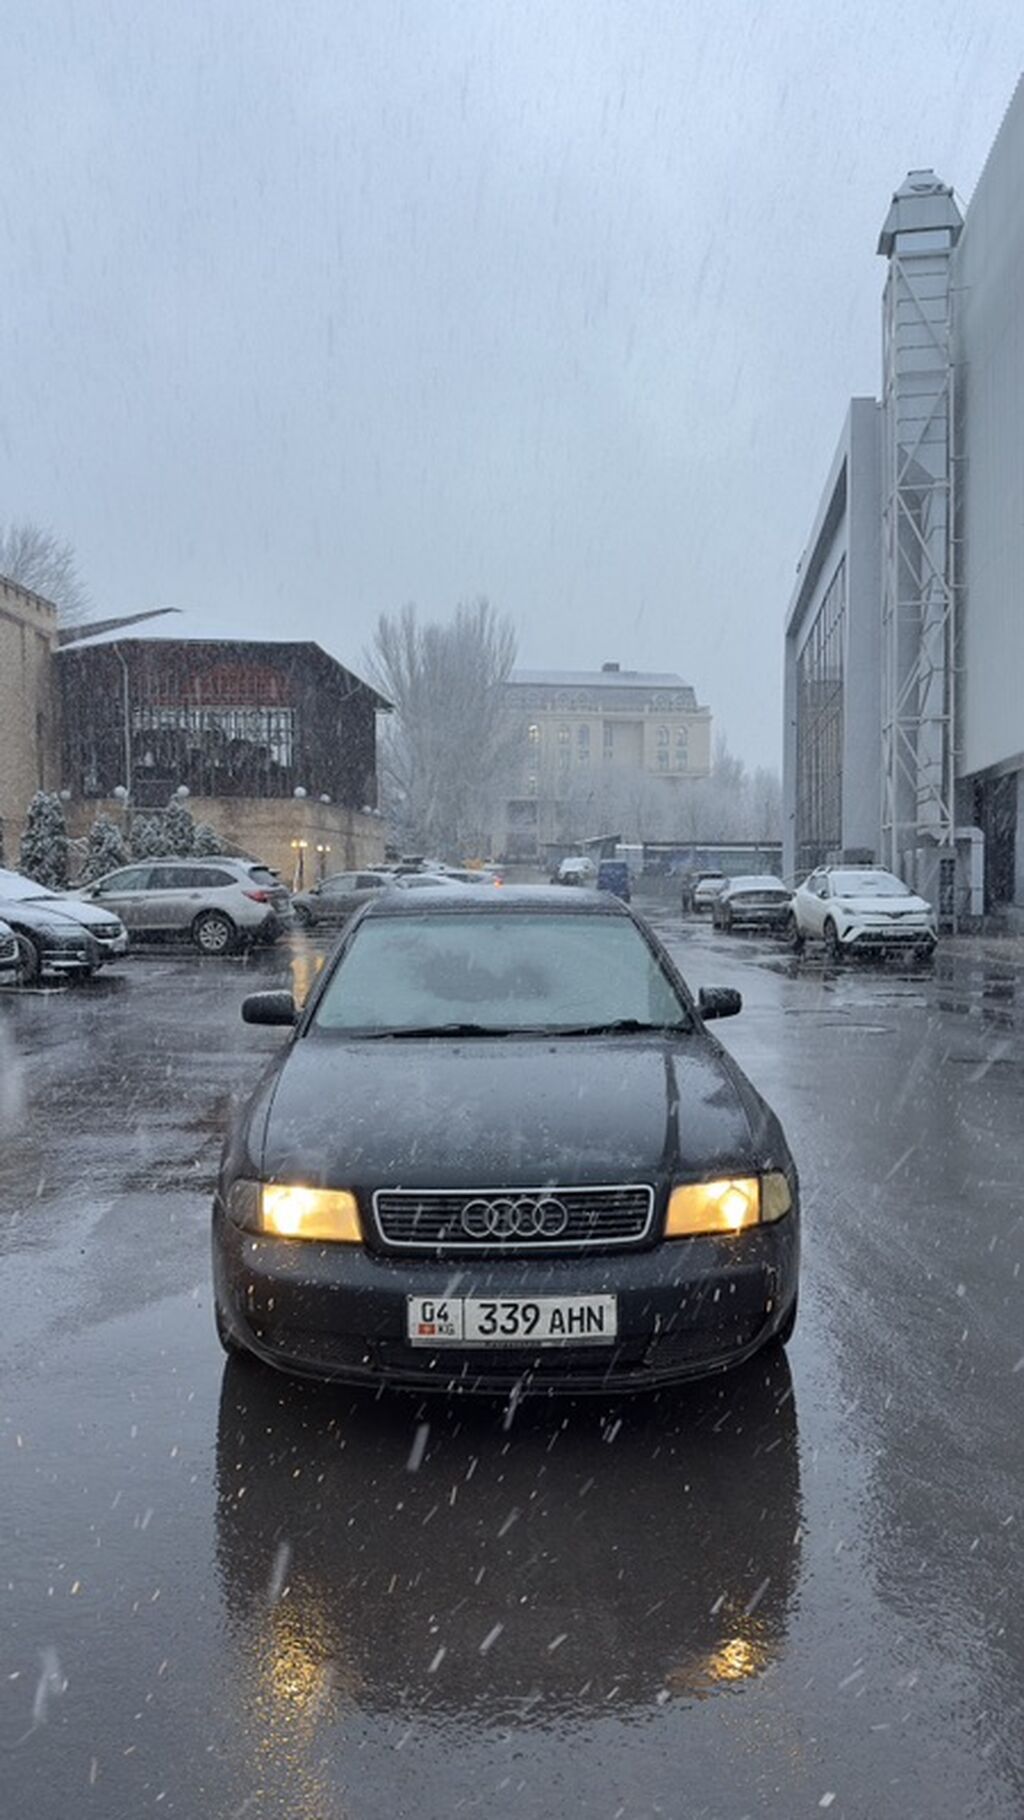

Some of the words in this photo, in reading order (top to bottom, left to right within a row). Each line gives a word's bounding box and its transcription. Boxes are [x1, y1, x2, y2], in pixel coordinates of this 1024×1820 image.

[421, 1301, 449, 1322] 04
[478, 1303, 540, 1335] 339
[549, 1305, 604, 1334] AHN
[438, 1324, 454, 1335] KG
